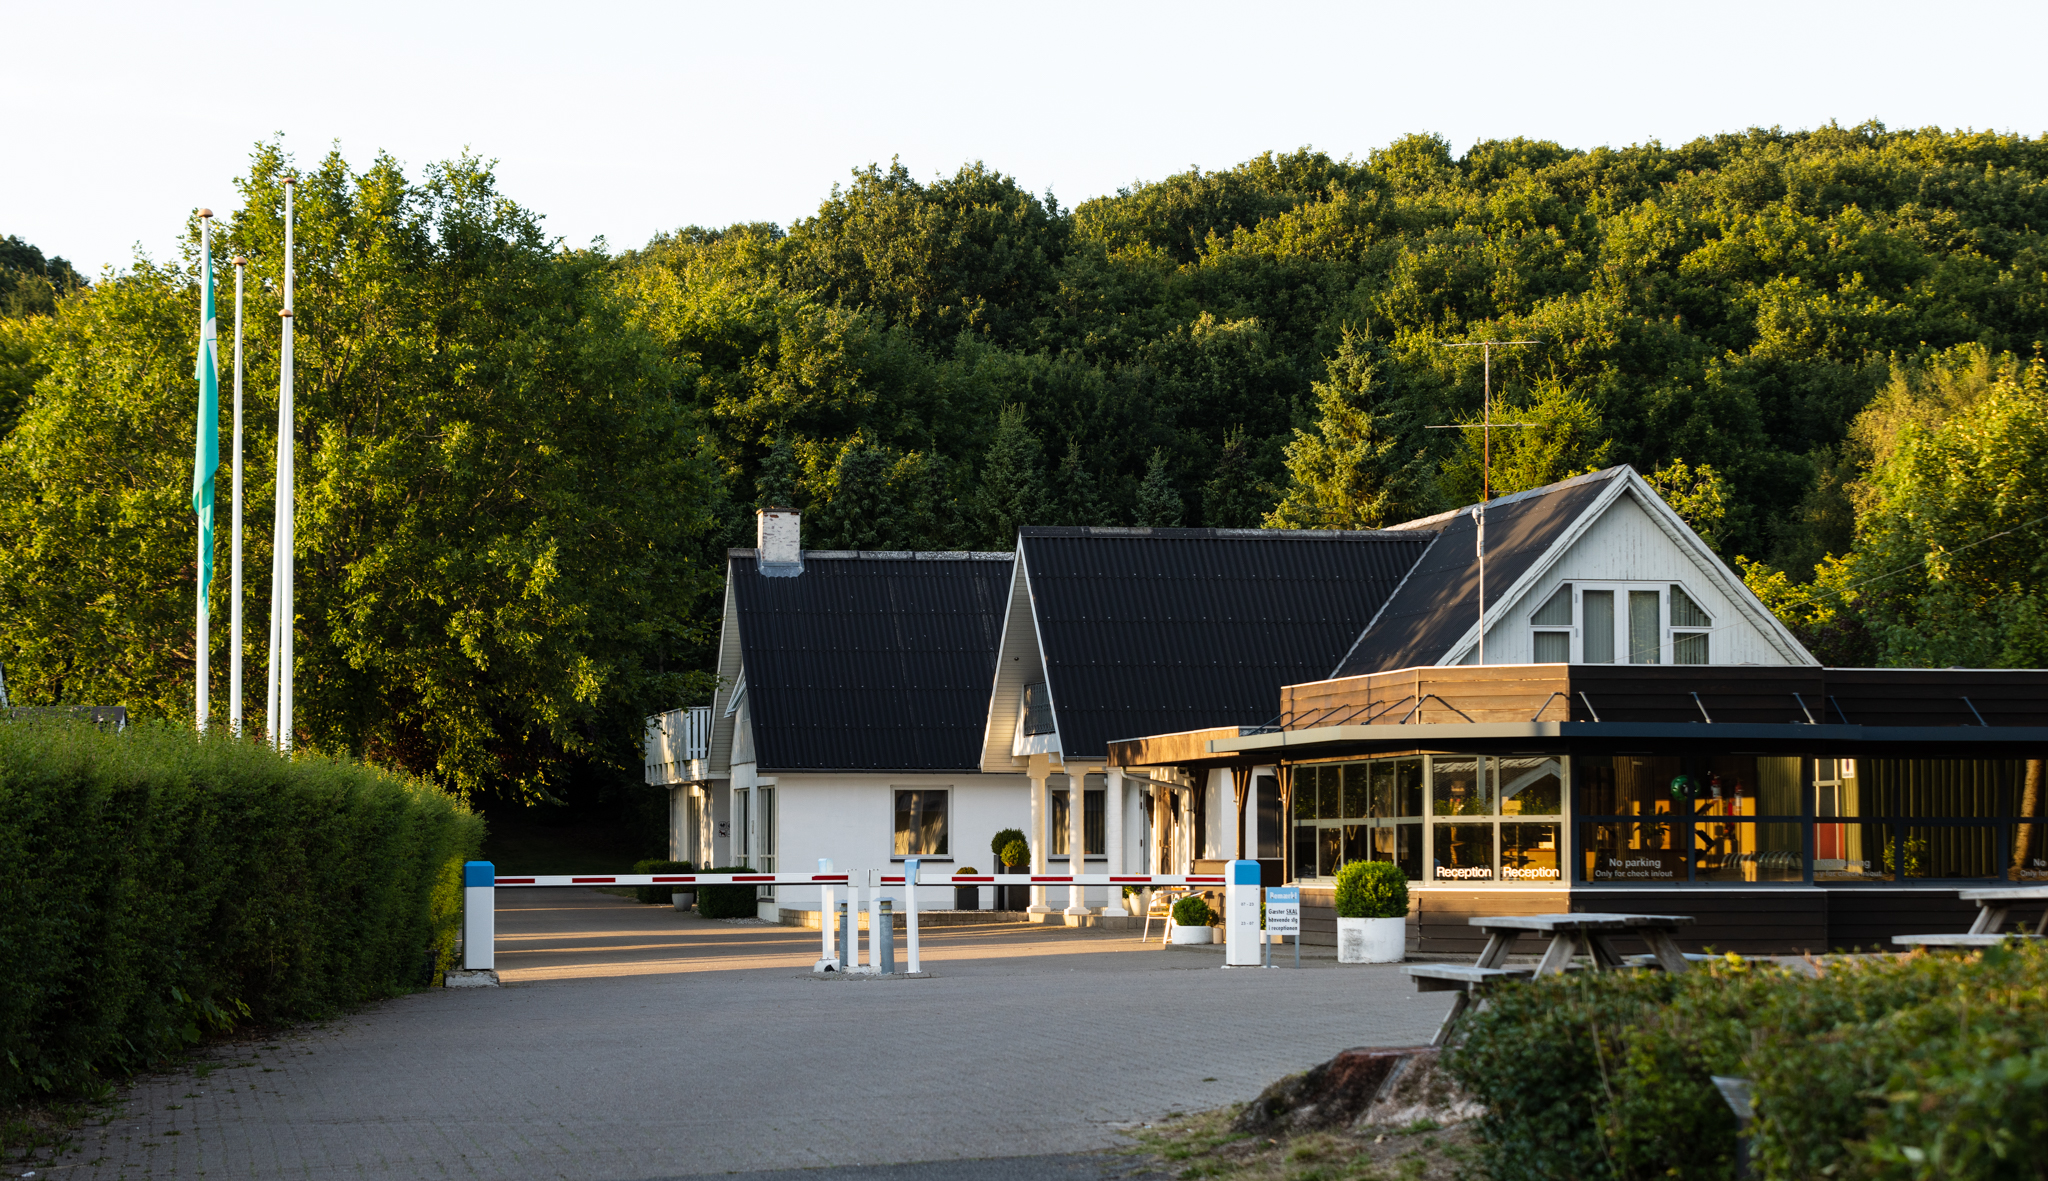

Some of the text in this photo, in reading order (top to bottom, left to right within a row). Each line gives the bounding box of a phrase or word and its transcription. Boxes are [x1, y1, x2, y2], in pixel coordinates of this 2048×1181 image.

[1609, 858, 1661, 869] No parking
[2033, 858, 2047, 867] No
[1436, 866, 1492, 880] Reception
[1503, 866, 1560, 880] Reception
[1595, 870, 1612, 878] Only
[2020, 870, 2037, 878] Only
